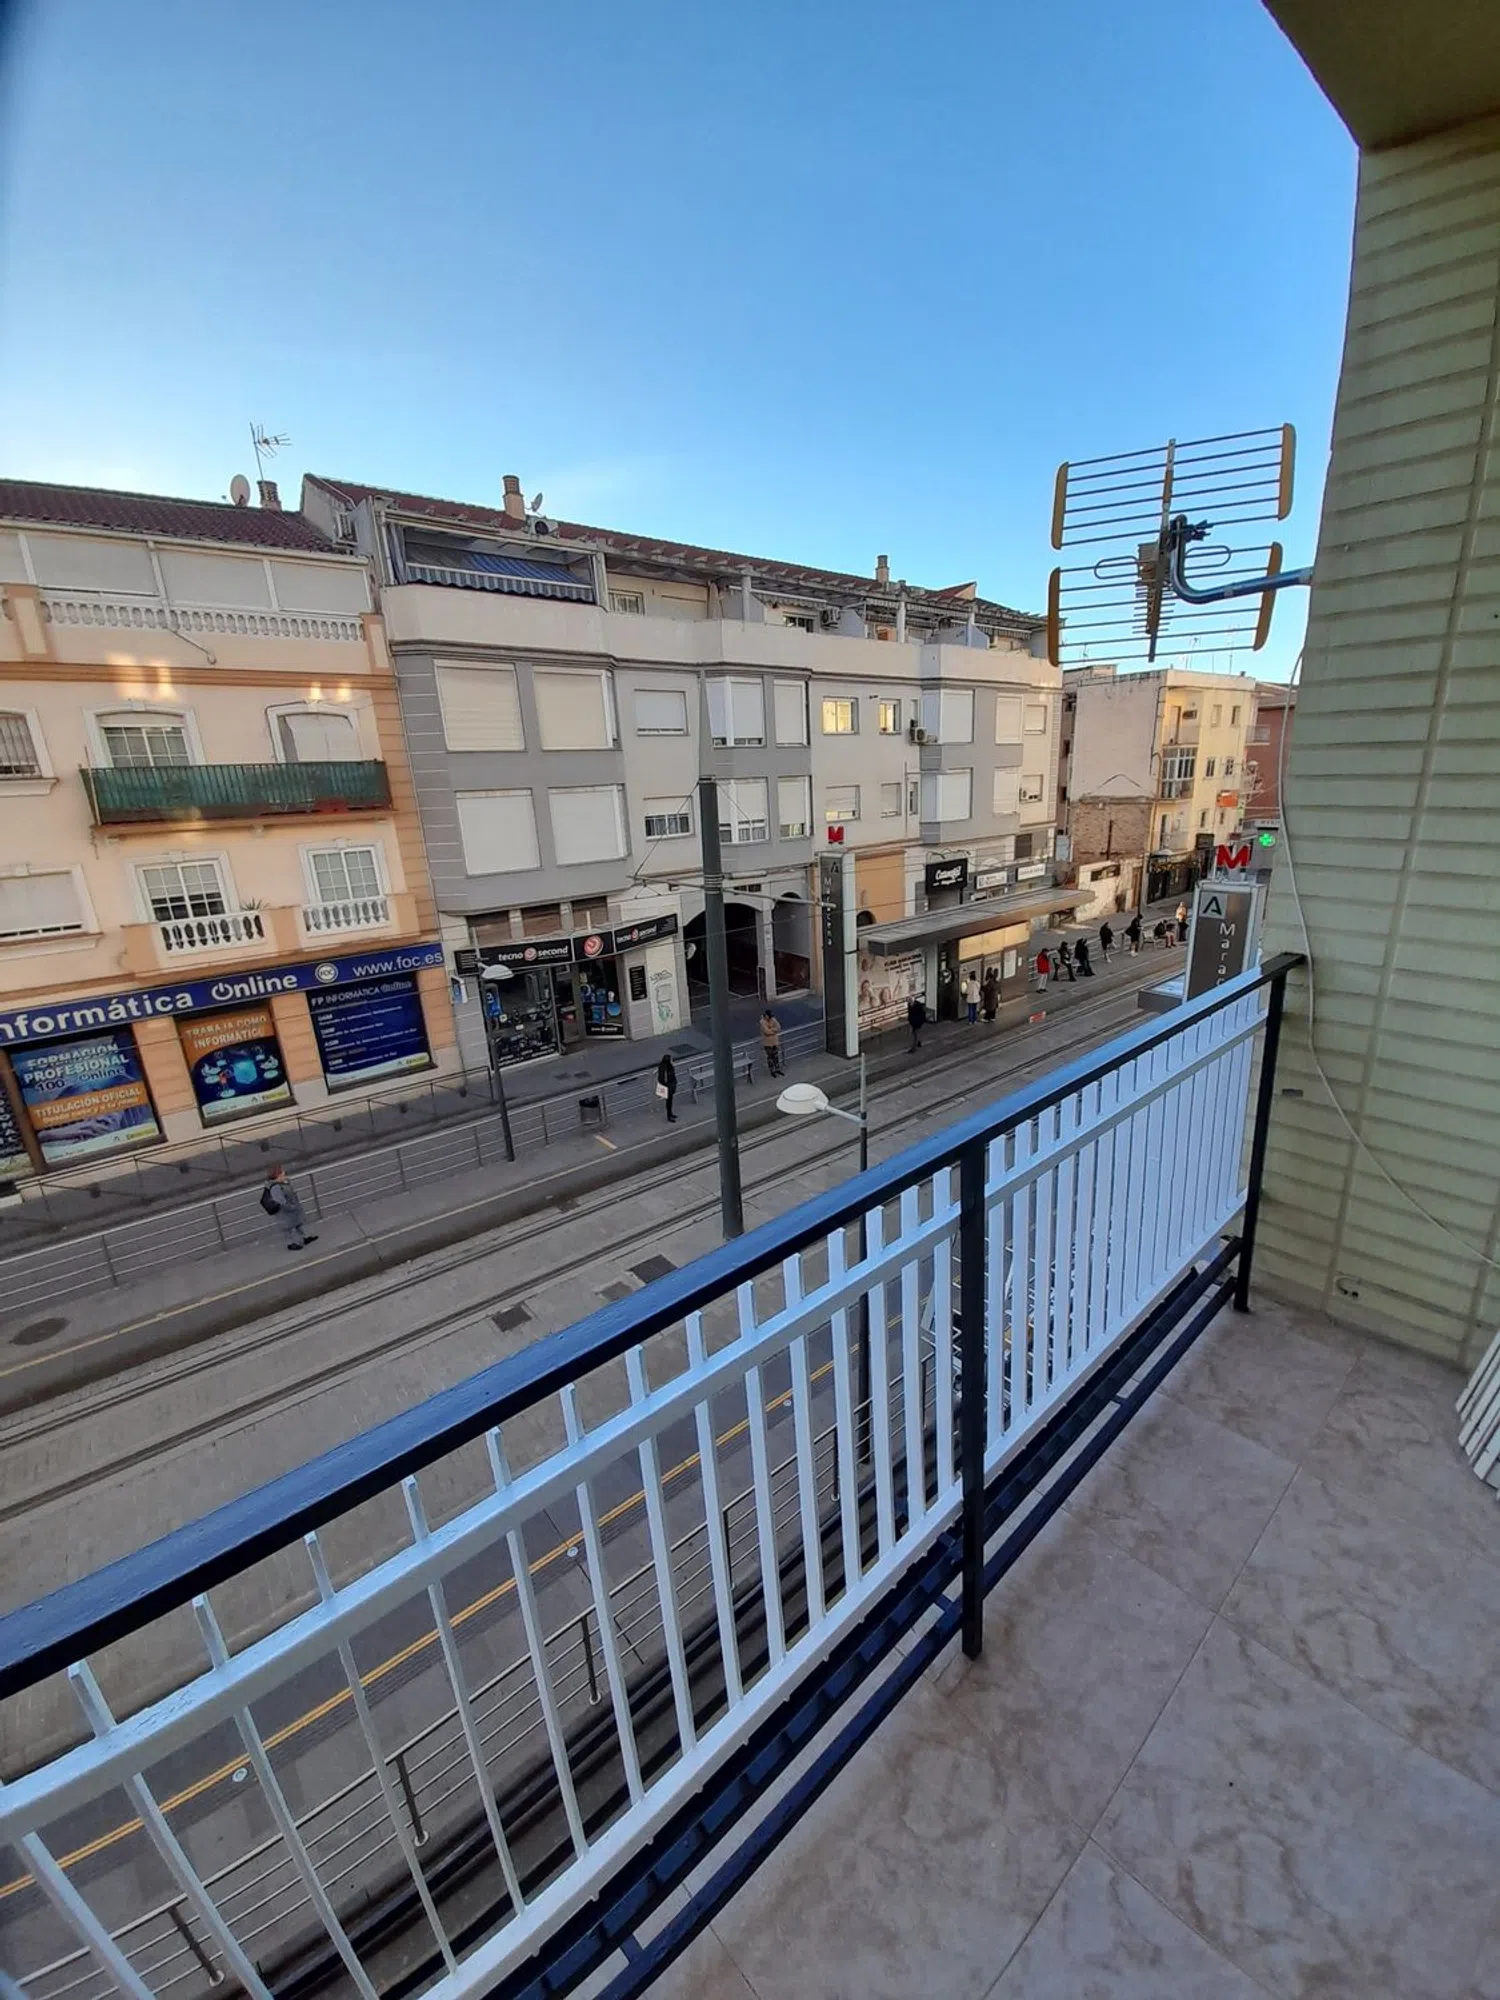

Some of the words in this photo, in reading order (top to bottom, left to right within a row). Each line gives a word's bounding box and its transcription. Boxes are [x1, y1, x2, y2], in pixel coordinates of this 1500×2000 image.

[1216, 844, 1250, 869] M
[498, 952, 524, 961] tecno
[538, 945, 568, 956] second
[352, 952, 443, 977] www.foc.es
[311, 997, 324, 1006] FP
[24, 1053, 130, 1084] PROFESIONAL
[101, 1087, 141, 1103] OFICIAL
